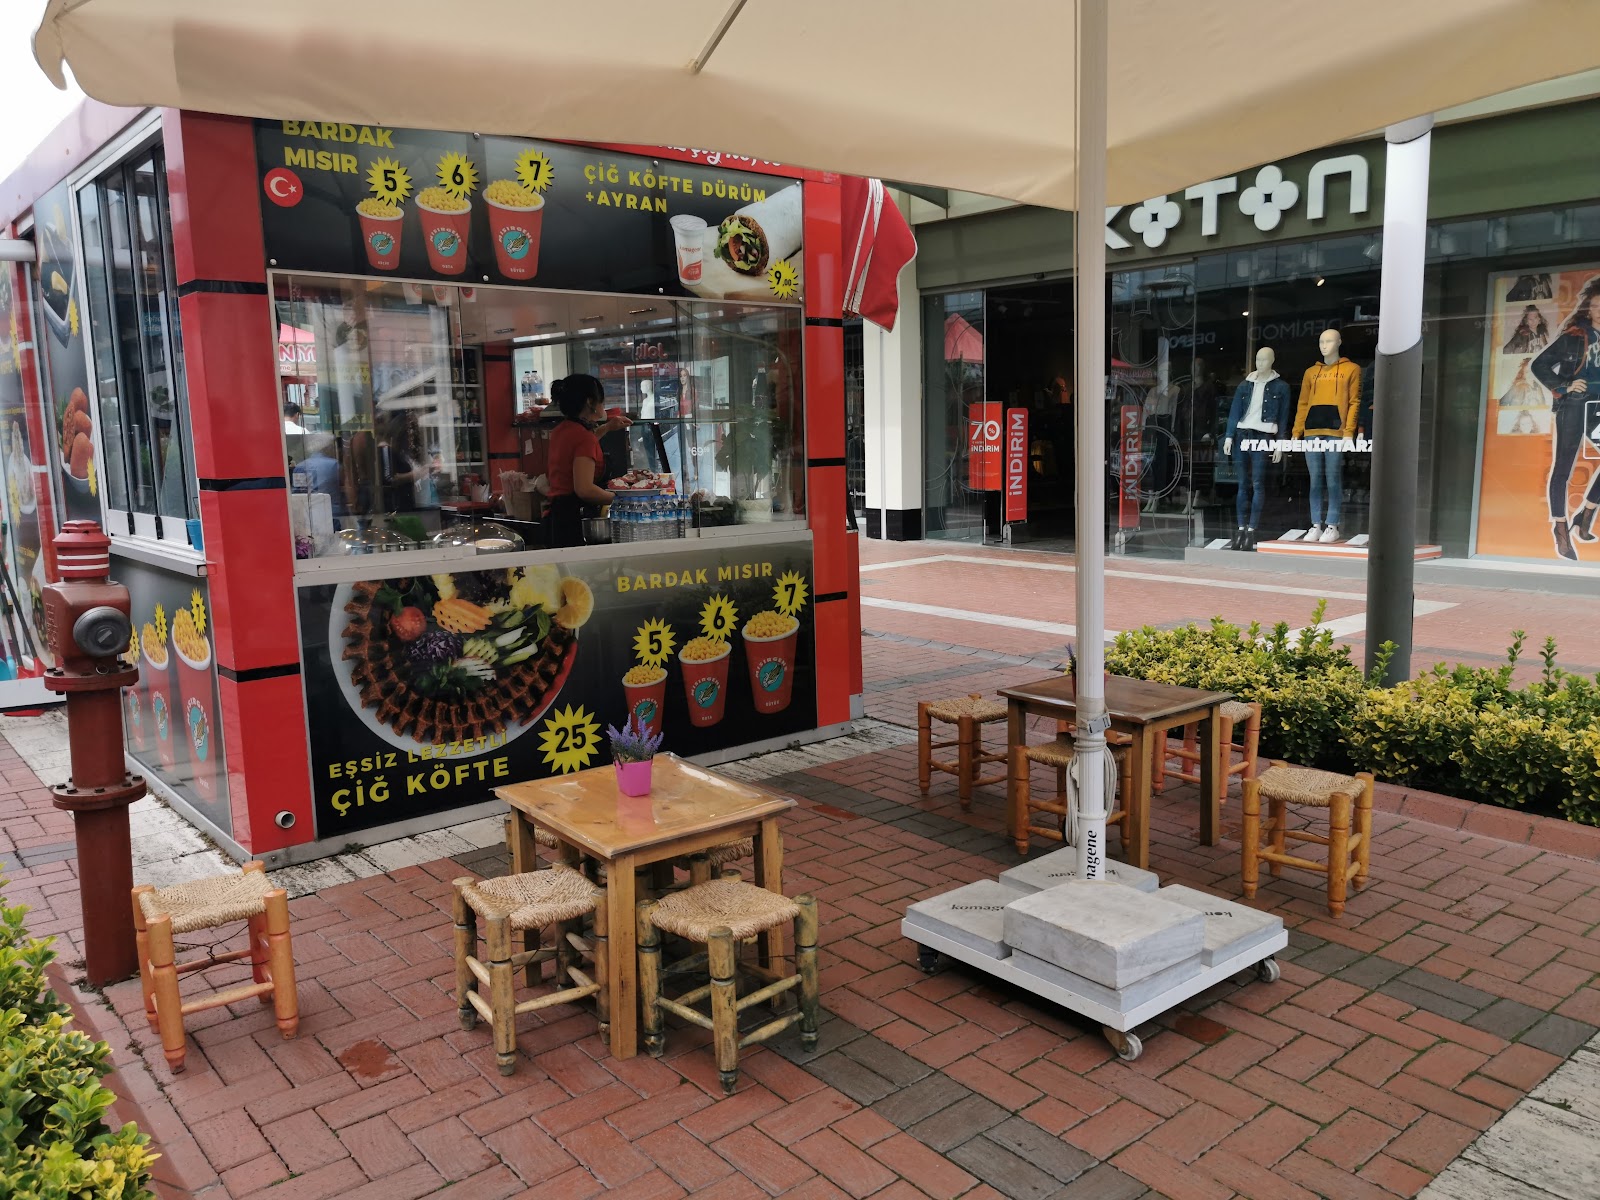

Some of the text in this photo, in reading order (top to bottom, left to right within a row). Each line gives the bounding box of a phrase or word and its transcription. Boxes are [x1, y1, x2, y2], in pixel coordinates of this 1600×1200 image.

[282, 120, 395, 149] BARDAK
[284, 147, 358, 174] MISIR
[530, 160, 541, 182] 7
[383, 169, 397, 192] 5
[451, 165, 464, 186] 6
[584, 161, 766, 204] ÇİĞ KÖFTE DÜRÜM
[585, 190, 668, 213] +AYRAN
[617, 562, 773, 593] BARDAK MISIR
[784, 583, 796, 607] 7
[713, 606, 726, 630] 6
[649, 630, 662, 655] 5
[555, 724, 587, 754] 25
[328, 729, 507, 780] EŞSİZ LEZZETLİ
[331, 756, 509, 817] ÇİĞ KÖFTE
